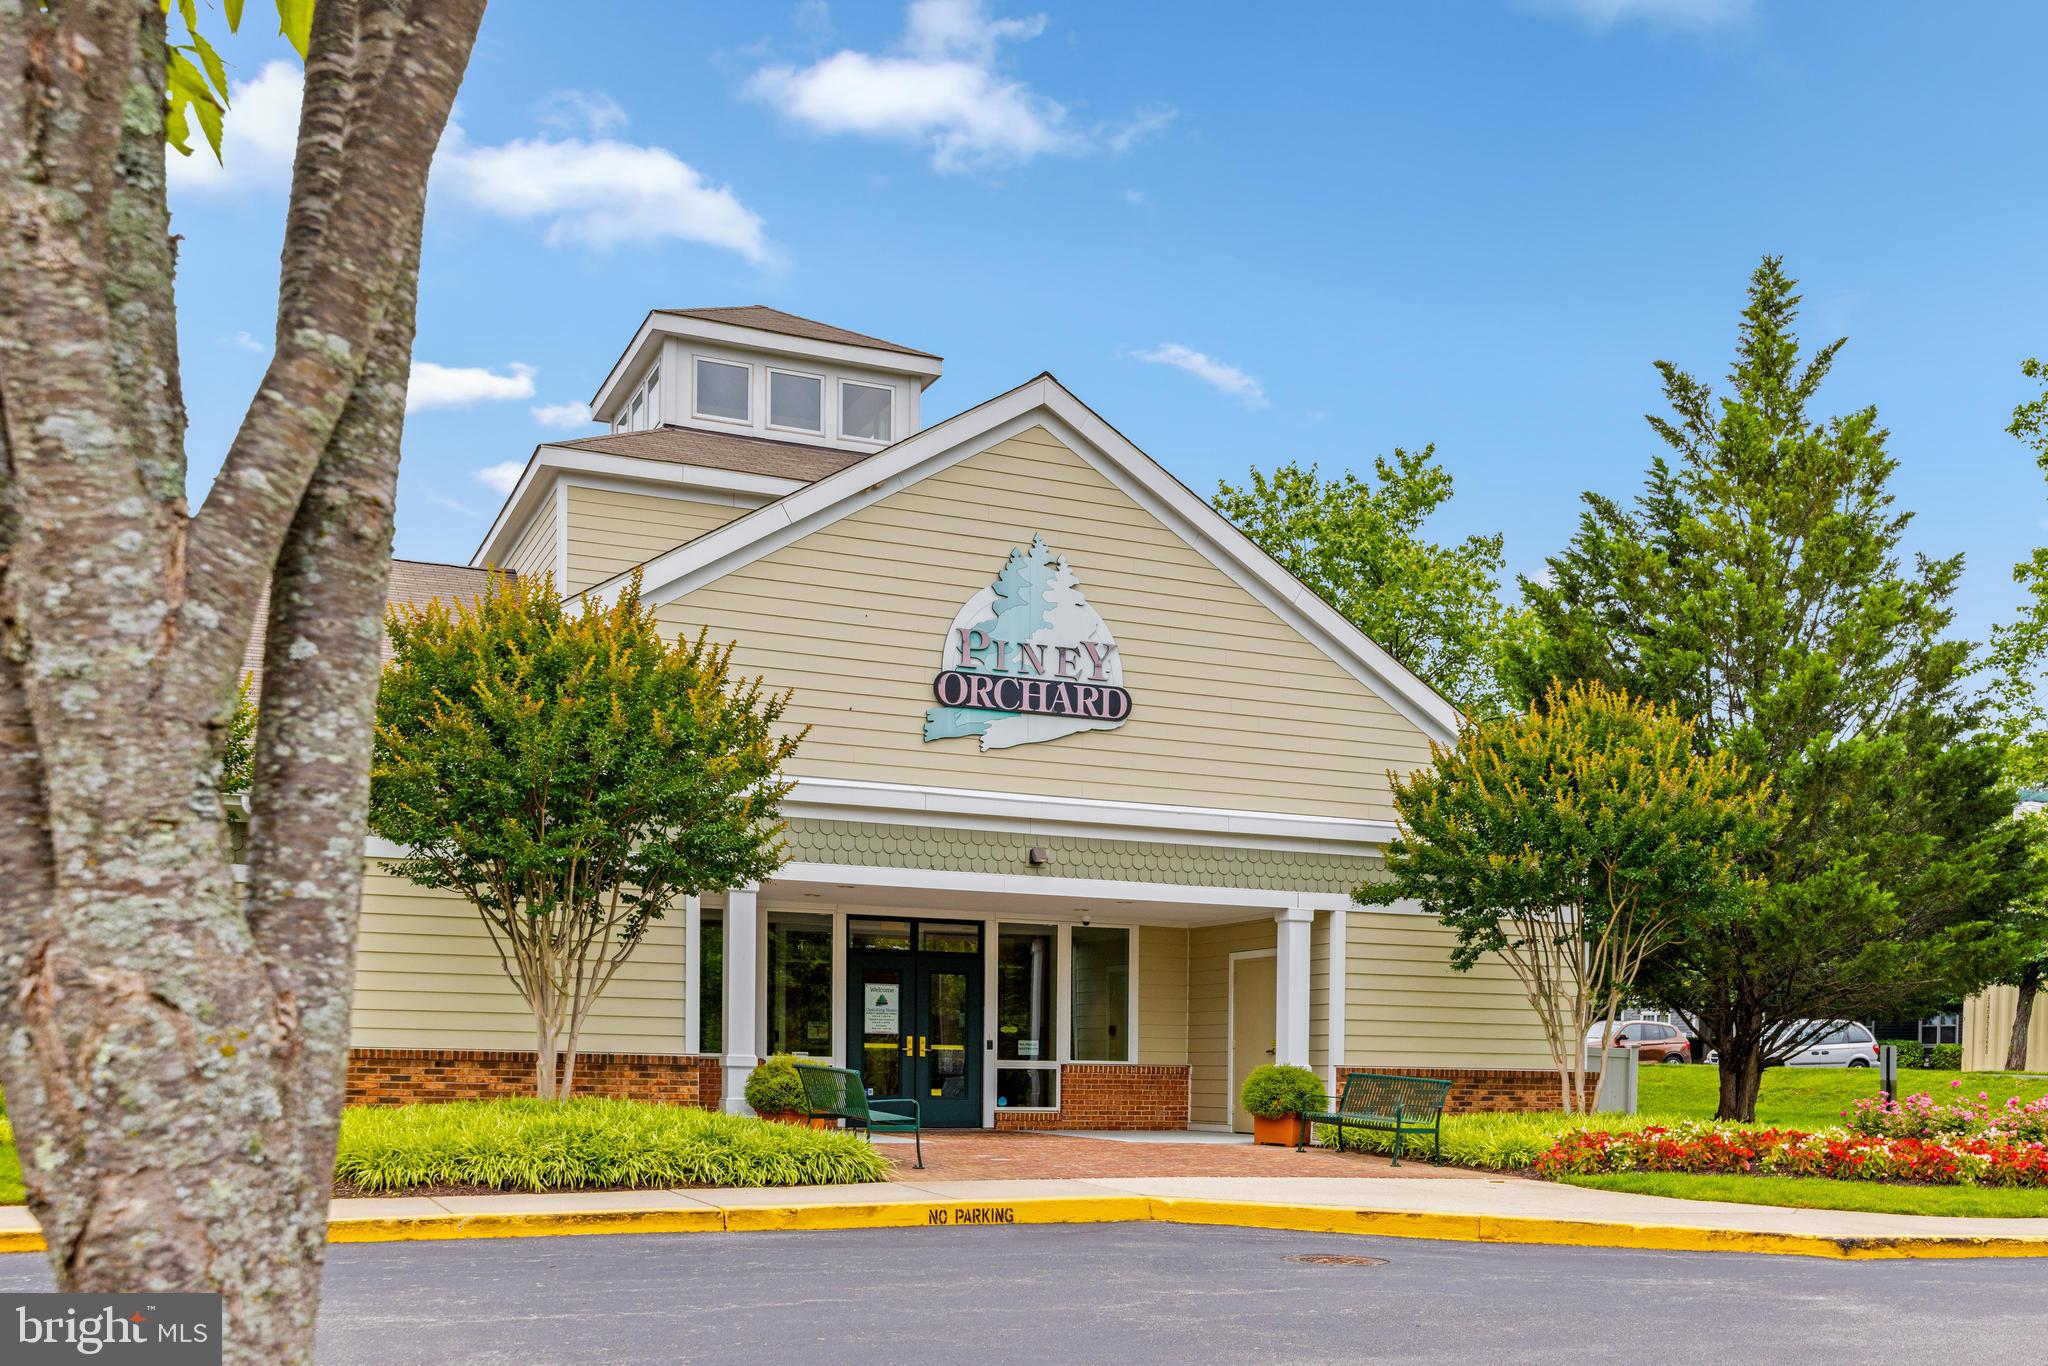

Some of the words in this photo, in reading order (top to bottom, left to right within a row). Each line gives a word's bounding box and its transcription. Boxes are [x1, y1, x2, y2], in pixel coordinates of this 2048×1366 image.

[955, 628, 1117, 681] PINEY
[937, 672, 1128, 719] ORCHARD
[928, 1209, 948, 1225] NO
[955, 1207, 1015, 1224] PARKING
